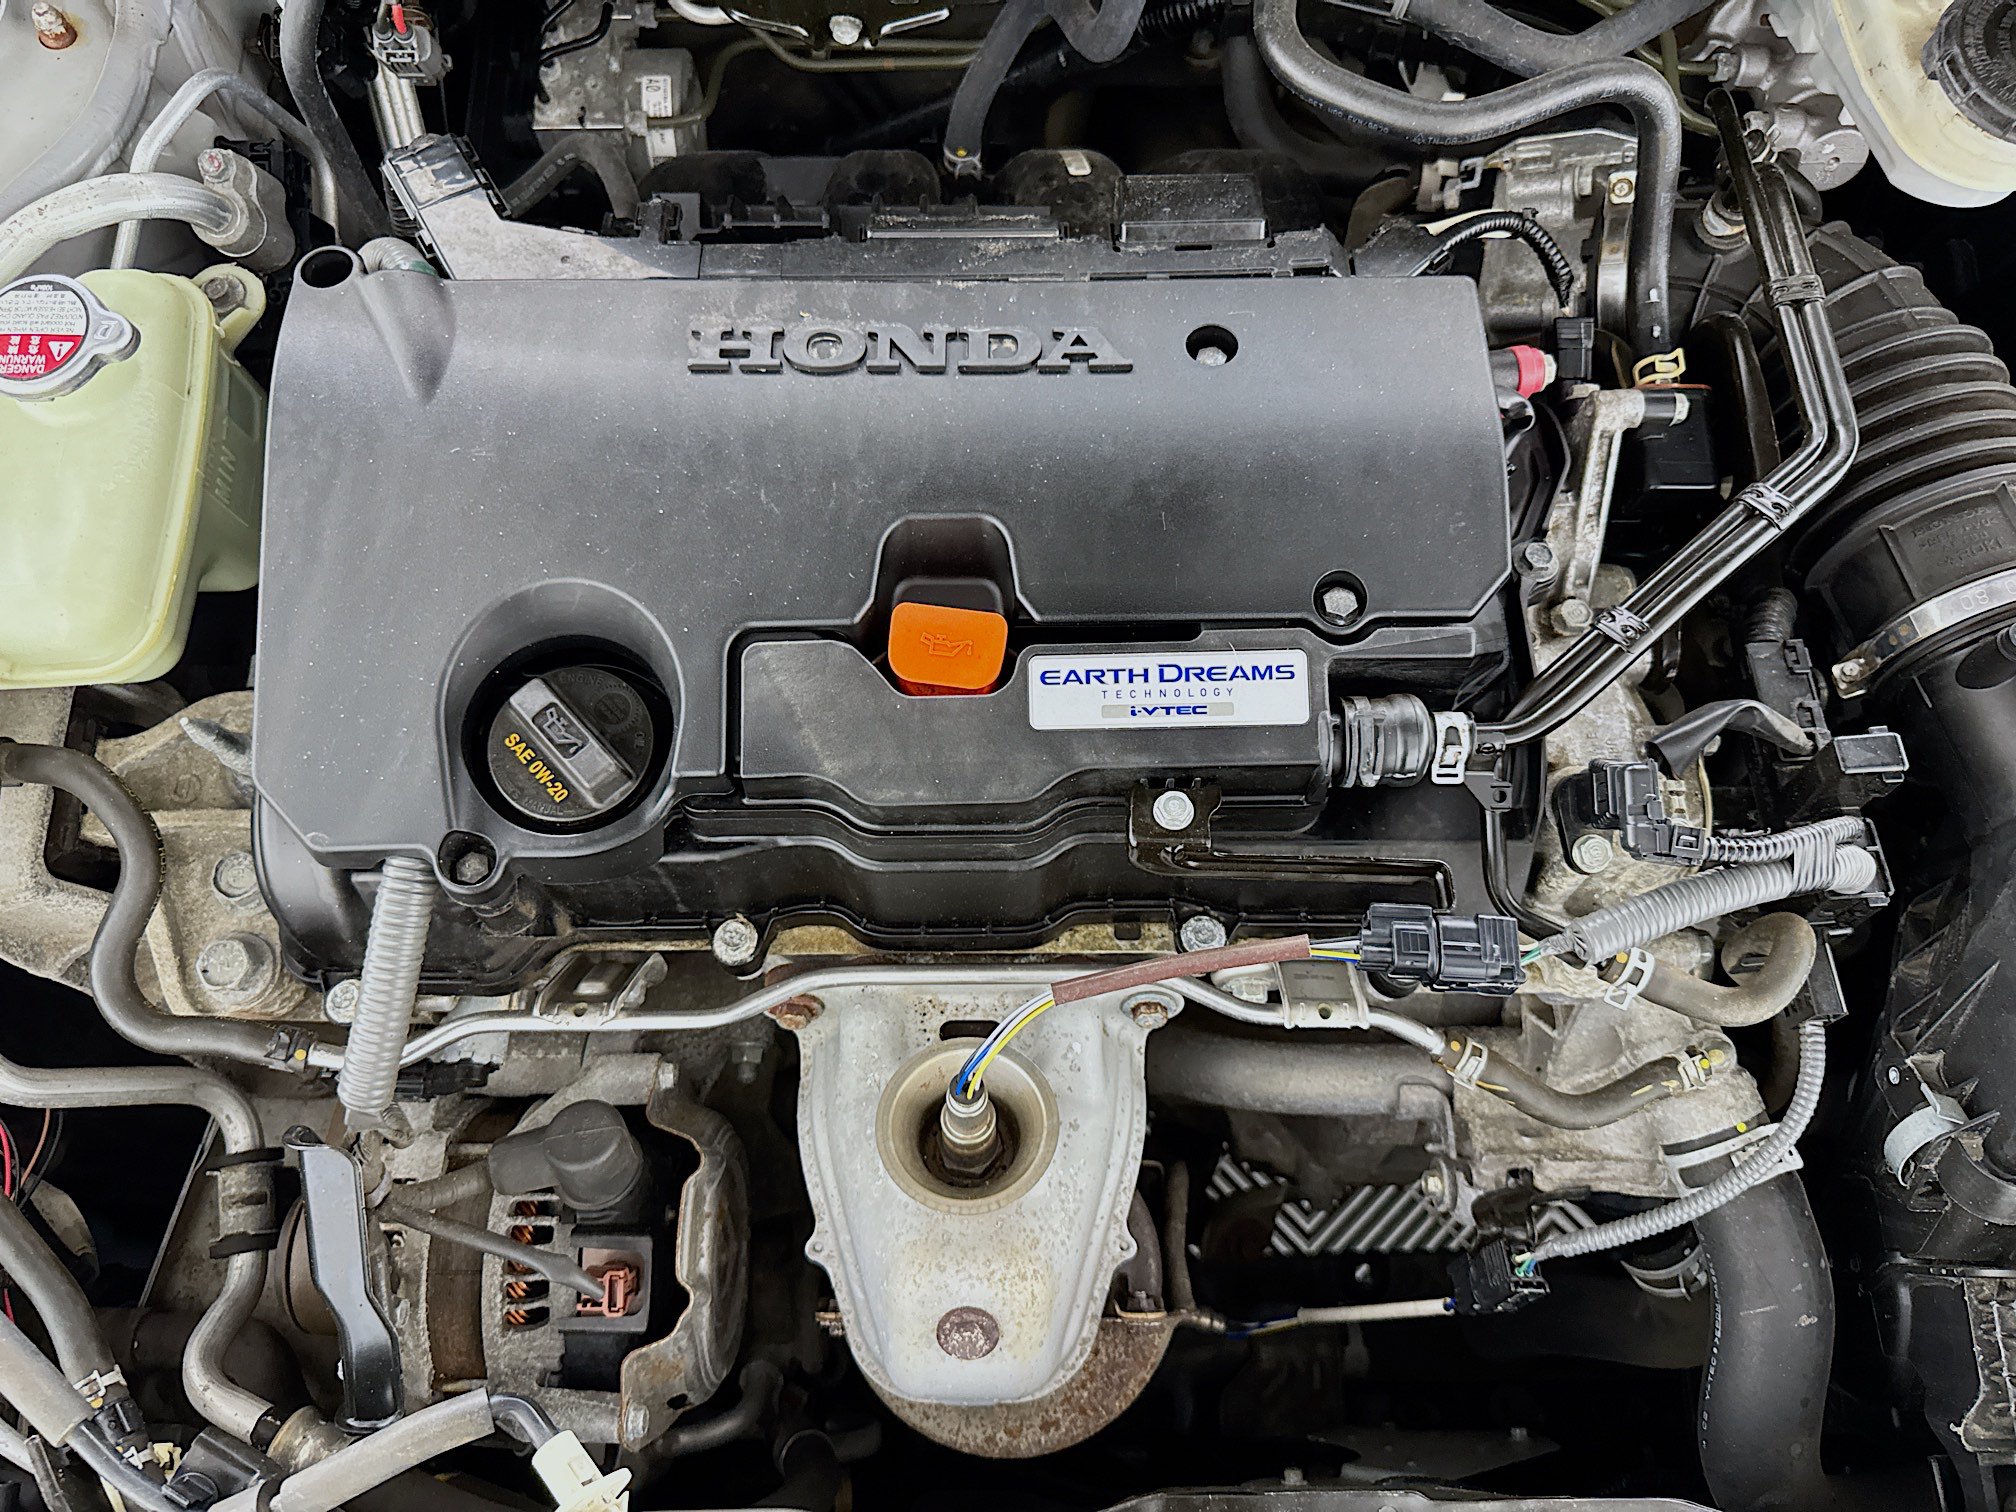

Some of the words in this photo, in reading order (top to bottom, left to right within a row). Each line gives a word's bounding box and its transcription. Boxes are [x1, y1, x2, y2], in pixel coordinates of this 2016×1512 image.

[687, 325, 1133, 375] HONDA
[0, 364, 45, 374] DANGER
[558, 672, 604, 686] ENGINE
[1039, 668, 1149, 686] EARTH
[1158, 664, 1295, 684] DREAMS
[1101, 687, 1234, 700] TECHNOLOGY
[1130, 705, 1208, 717] i-VTEC
[634, 731, 647, 749] OIL
[504, 733, 536, 765] SAE
[528, 760, 569, 803] 0W-20
